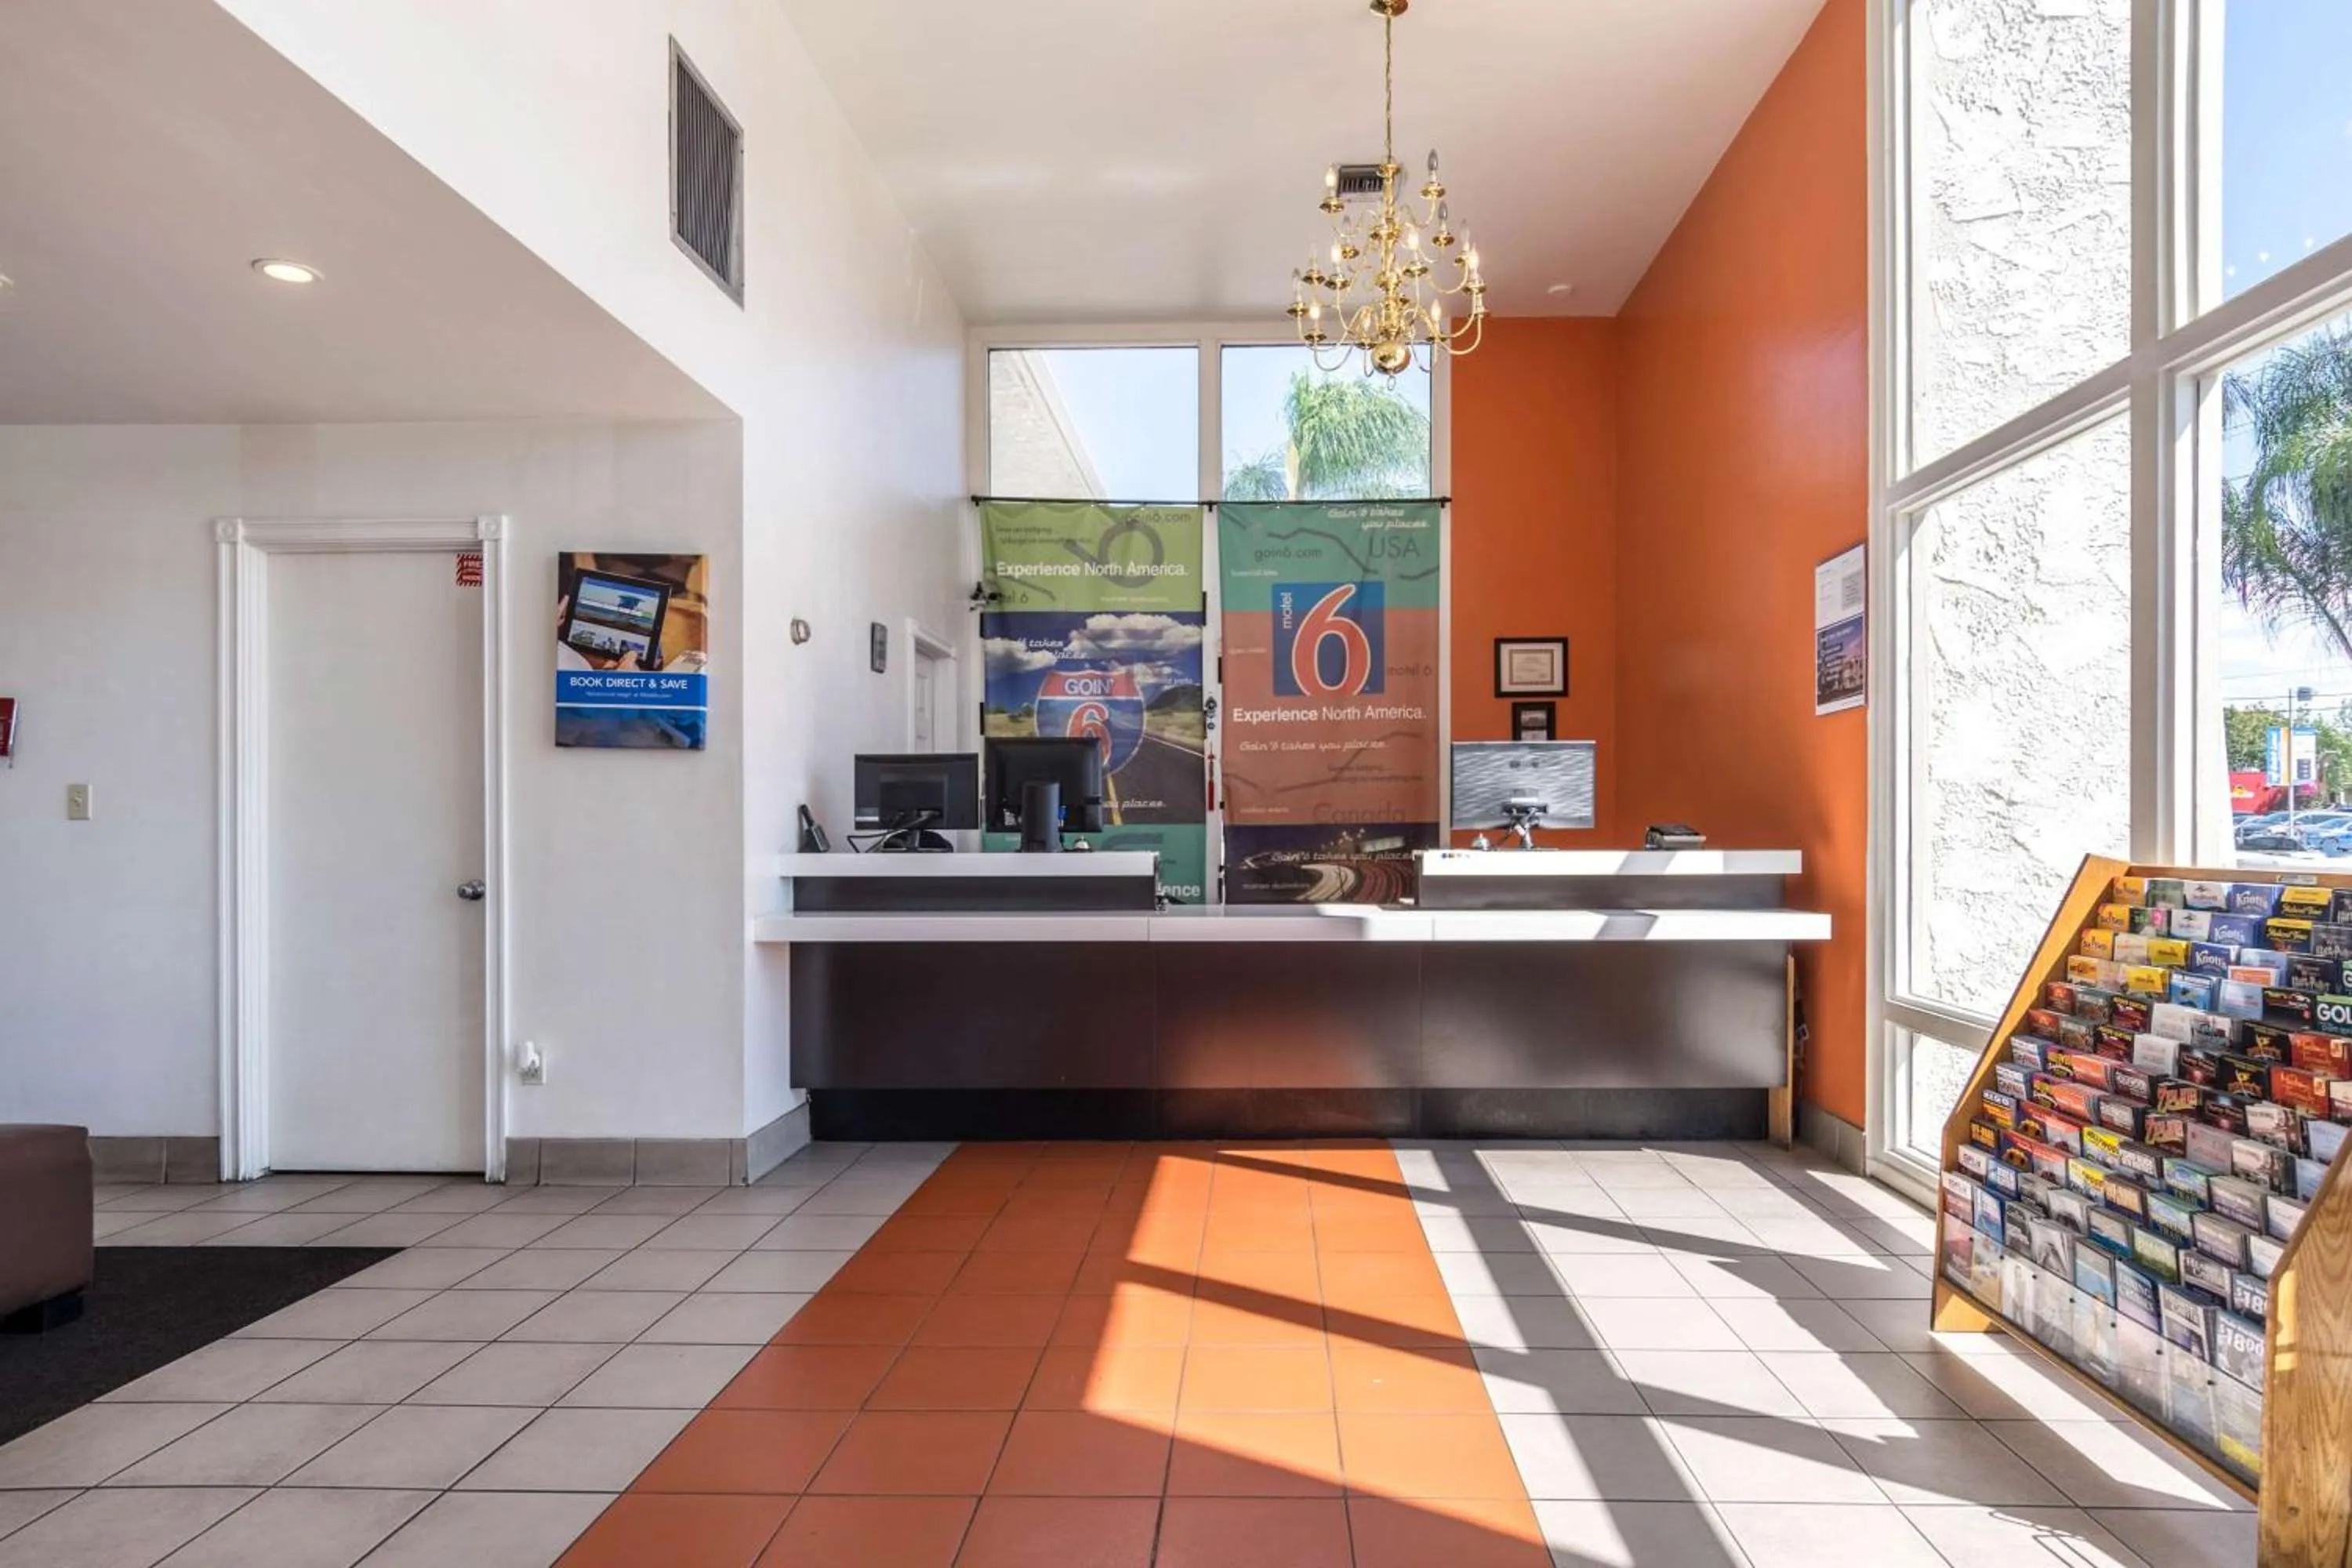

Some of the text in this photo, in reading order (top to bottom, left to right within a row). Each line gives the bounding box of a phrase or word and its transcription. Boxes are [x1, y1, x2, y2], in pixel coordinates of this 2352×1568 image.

[1368, 535, 1421, 558] USA
[996, 561, 1189, 579] Experience North America.
[1279, 583, 1371, 697] motel 6
[570, 677, 688, 689] BOOK DIRECT & SAVE
[1065, 677, 1114, 695] GOIN'
[1232, 704, 1427, 725] Experience North America.
